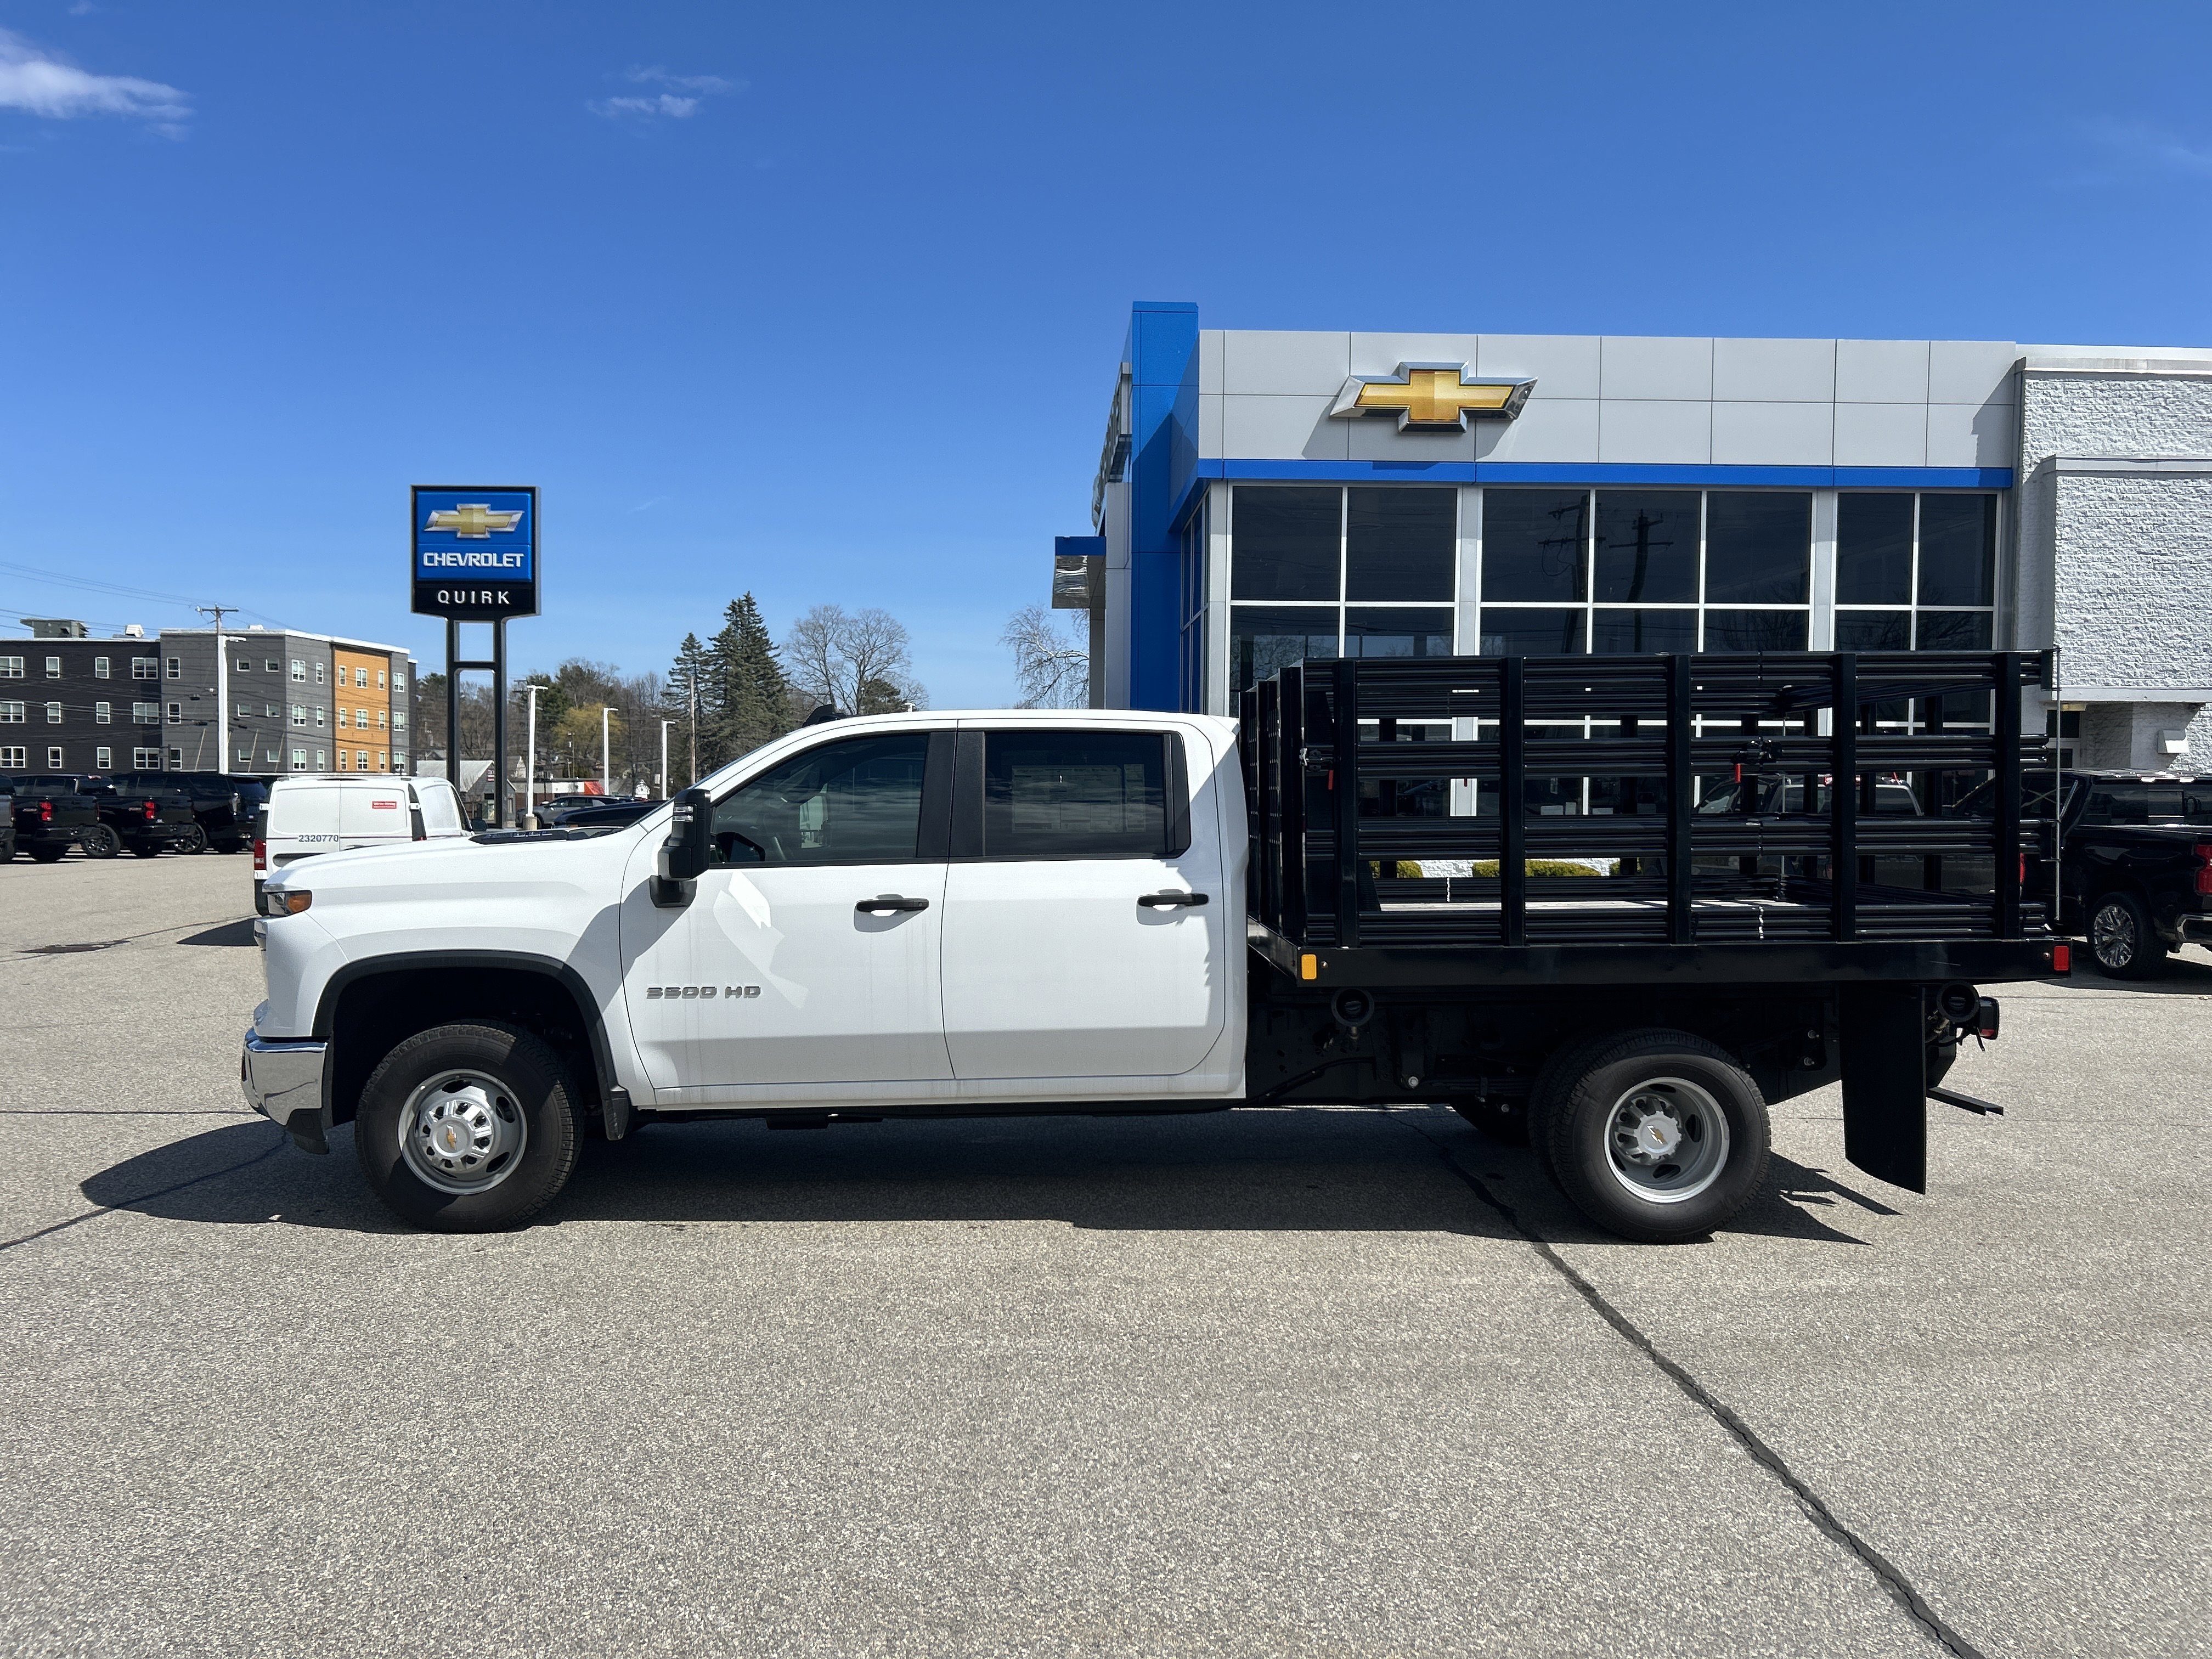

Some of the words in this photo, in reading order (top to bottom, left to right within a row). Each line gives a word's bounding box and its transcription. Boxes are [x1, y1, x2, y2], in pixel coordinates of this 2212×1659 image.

[423, 552, 524, 567] CHEVROLET
[437, 590, 510, 604] QUIRK
[1875, 854, 1995, 864] CHEVOLET
[646, 986, 718, 999] 3500
[725, 986, 761, 999] HD
